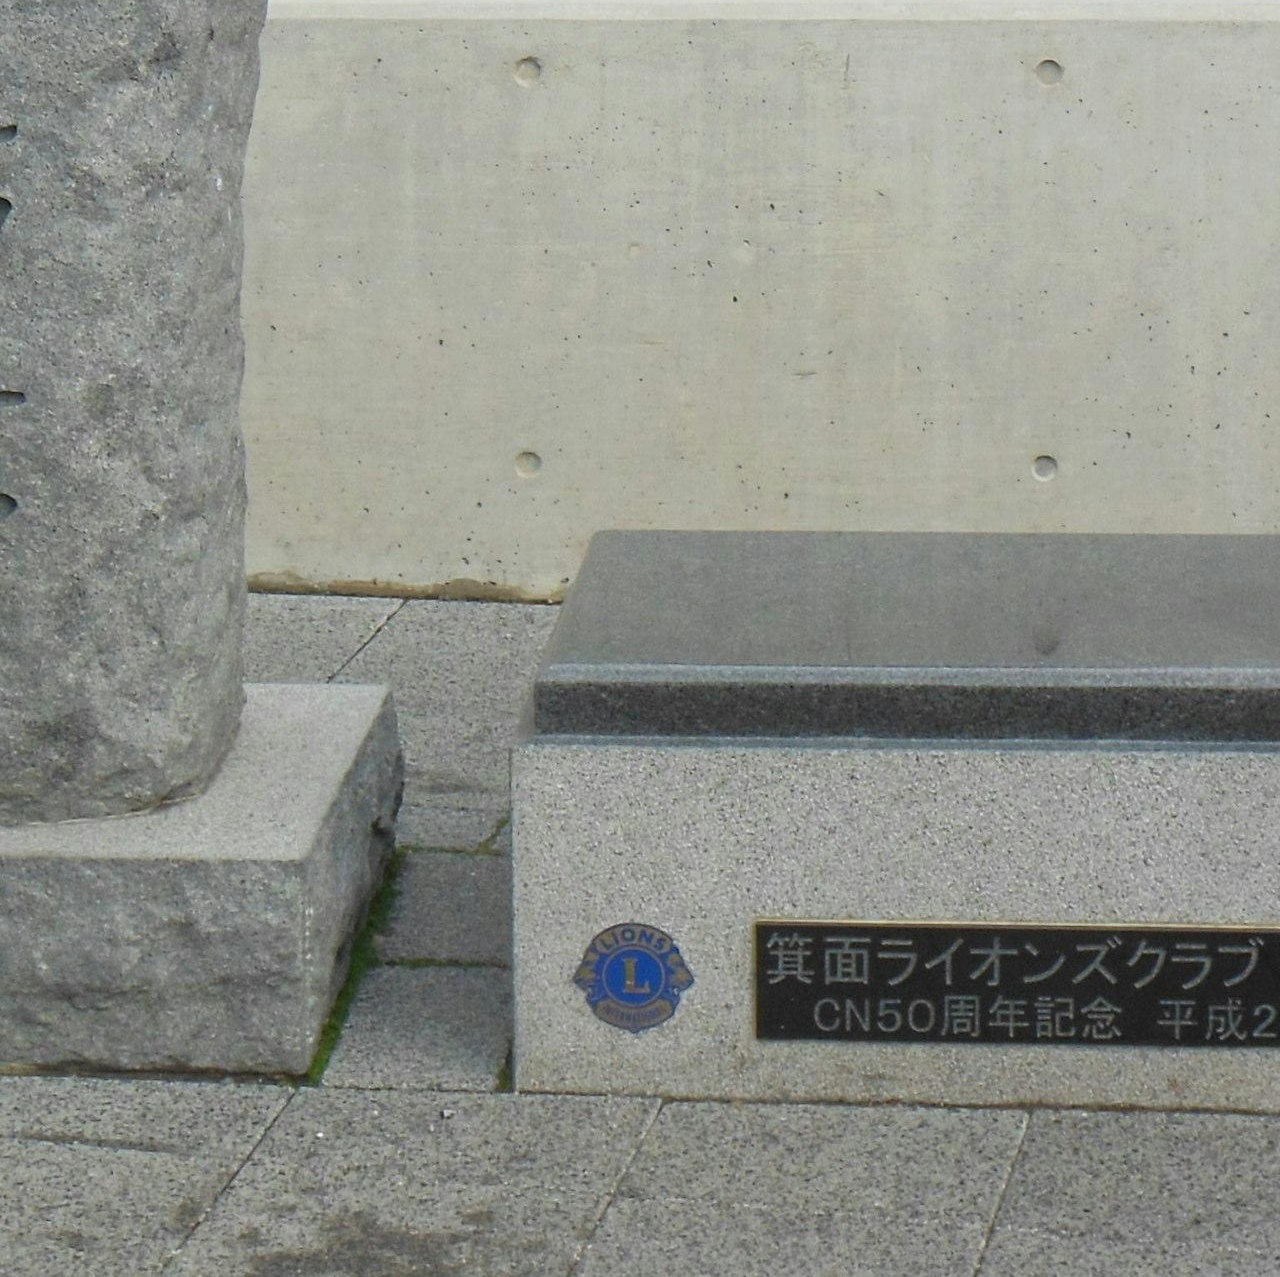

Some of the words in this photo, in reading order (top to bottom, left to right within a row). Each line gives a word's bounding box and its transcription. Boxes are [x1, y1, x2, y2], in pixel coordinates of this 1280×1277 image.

[598, 926, 669, 951] LIONS
[622, 956, 651, 995] L
[766, 931, 1265, 991] 箕面ライオンズクラブ
[812, 994, 1123, 1041] CN50周年記念
